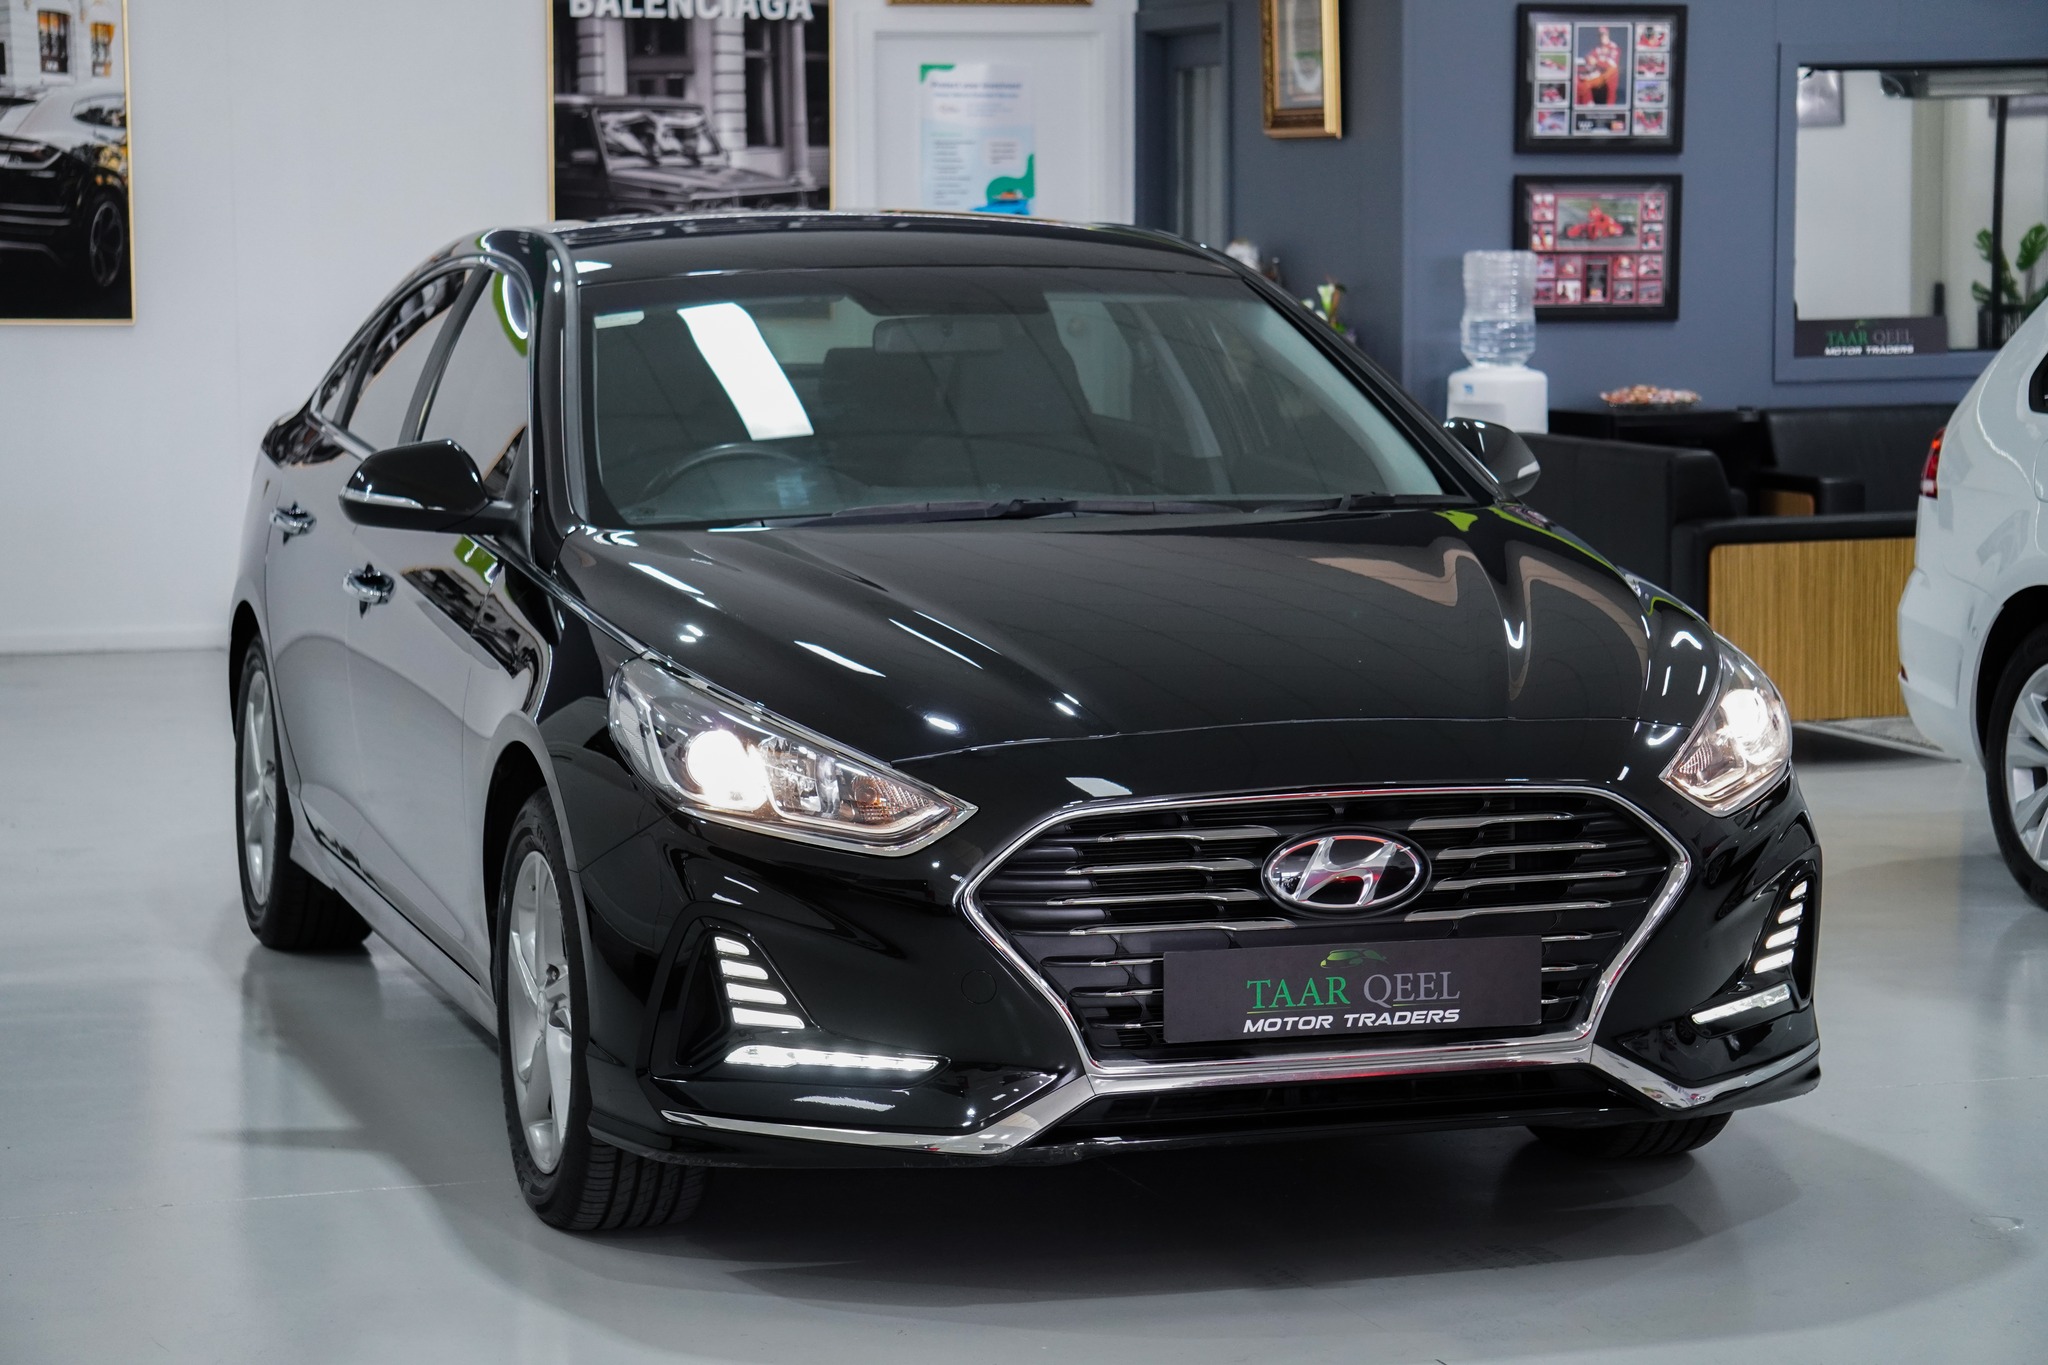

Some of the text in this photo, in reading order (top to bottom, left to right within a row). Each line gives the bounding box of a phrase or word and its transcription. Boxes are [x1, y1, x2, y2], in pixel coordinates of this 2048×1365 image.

[570, 0, 814, 20] BALENCIAGA
[1826, 328, 1914, 346] TAAR QEEL
[1824, 344, 1914, 356] MOTOR TRADERS
[1246, 971, 1461, 1008] TAAR QEEL
[1243, 1008, 1461, 1033] MOTOR TRADERS
